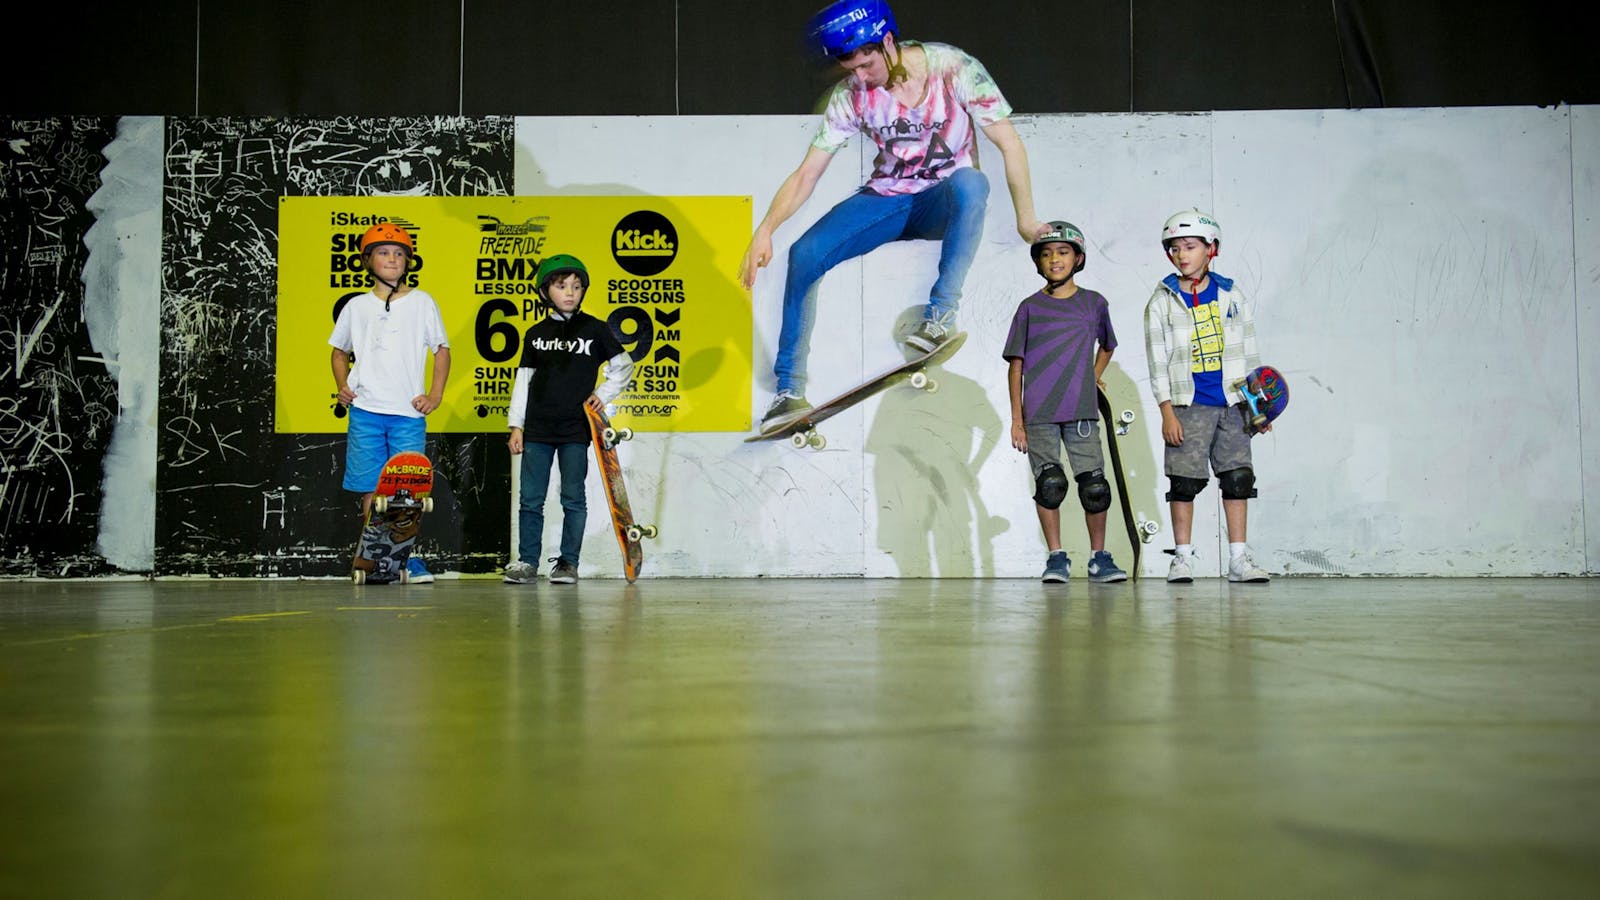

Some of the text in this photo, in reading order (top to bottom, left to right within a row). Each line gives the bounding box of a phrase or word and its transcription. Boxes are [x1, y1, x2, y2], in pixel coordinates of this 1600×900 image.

[331, 211, 388, 226] iSkate
[331, 233, 418, 252] SKE
[480, 236, 546, 256] FREERIDE
[616, 229, 674, 249] Kick.
[331, 254, 423, 272] BOD
[476, 258, 542, 280] BMX
[330, 274, 419, 288] LESSS
[475, 283, 539, 295] LESSON
[608, 279, 684, 291] SCOOTER
[608, 292, 685, 304] LESSONS
[523, 299, 550, 320] PM
[475, 298, 519, 363] 6
[607, 305, 654, 363] 9
[656, 330, 680, 341] AM
[474, 381, 510, 395] 1HR
